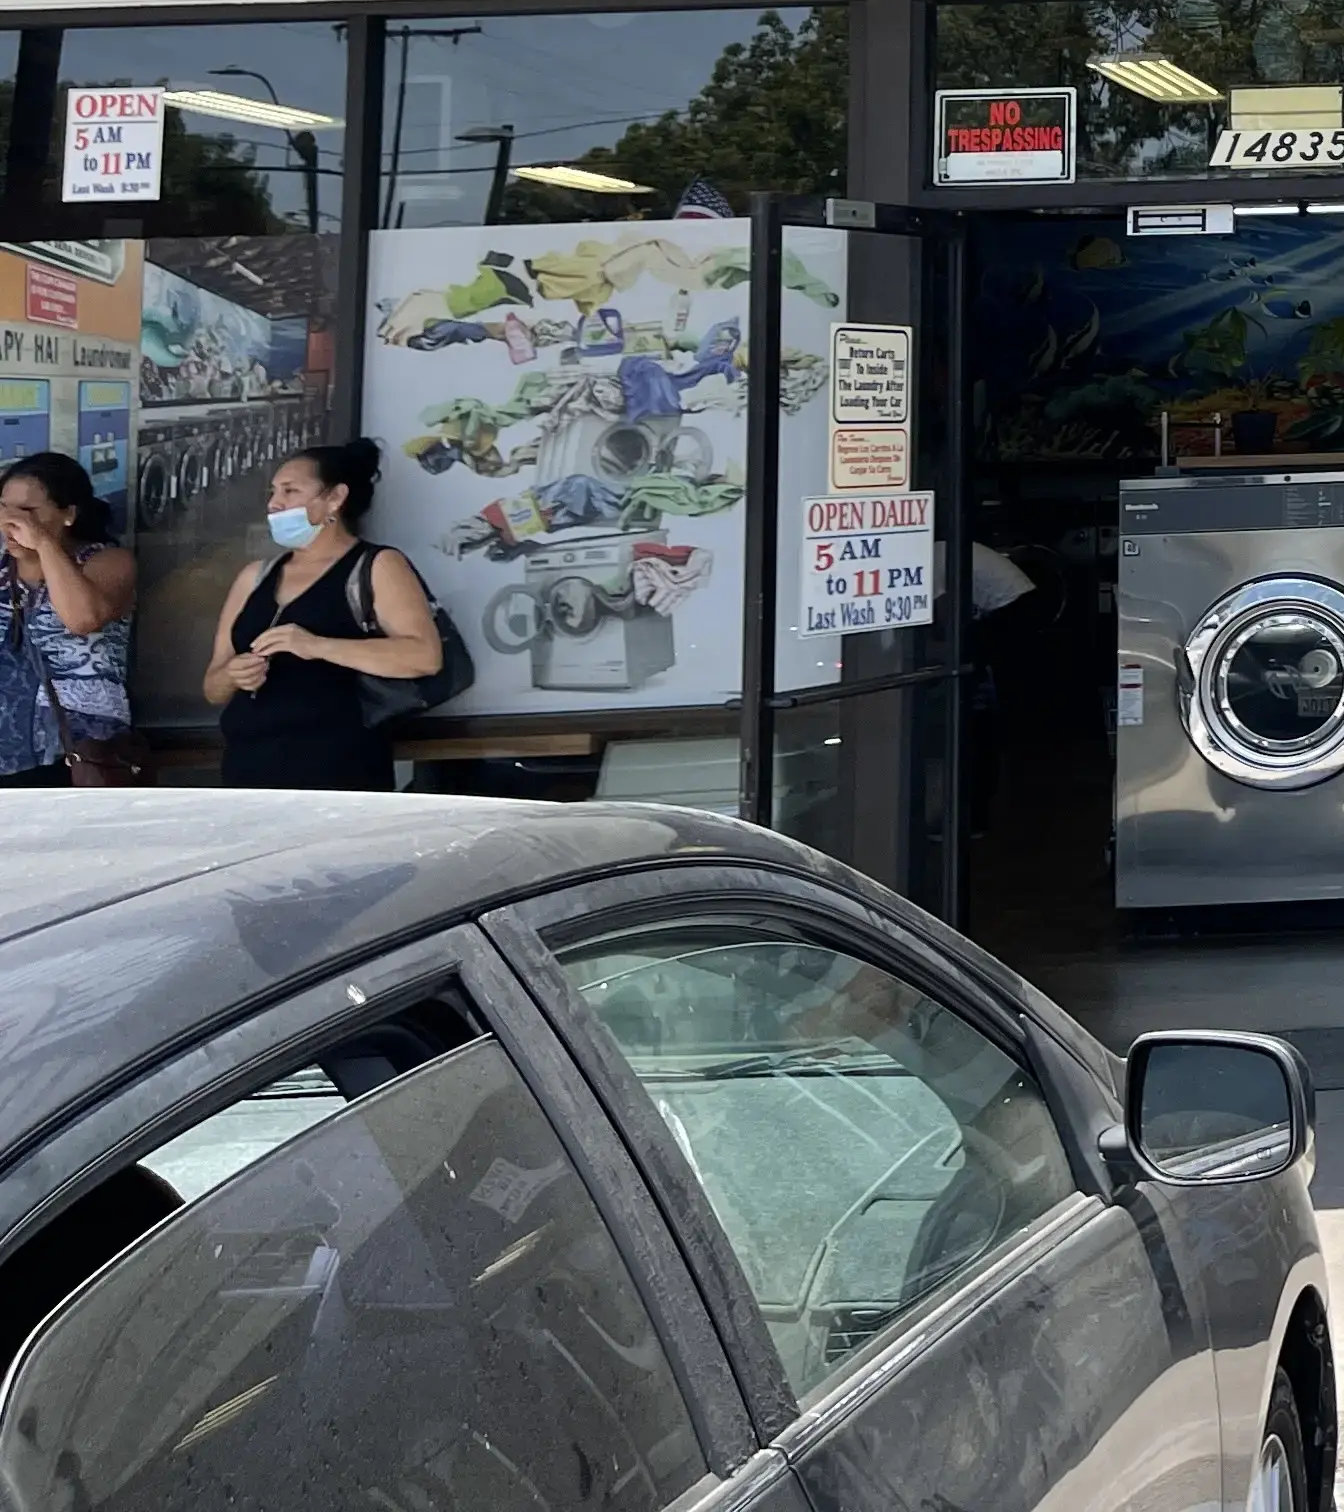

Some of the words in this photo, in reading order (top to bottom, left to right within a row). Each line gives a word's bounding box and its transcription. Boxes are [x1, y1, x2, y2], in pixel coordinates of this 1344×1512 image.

[75, 94, 158, 118] OPEN
[989, 101, 1021, 126] NO
[74, 128, 89, 151] 5
[92, 126, 123, 144] AM
[948, 127, 1063, 152] TRESPASSING
[84, 153, 98, 172] to
[101, 152, 122, 176] 11
[124, 152, 152, 170] PM
[0, 330, 24, 363] PY
[34, 333, 58, 365] HAI
[839, 379, 852, 391] The
[854, 380, 883, 393] Laundry
[886, 380, 904, 391] After
[840, 396, 869, 410] Loading
[890, 396, 902, 407] Car
[808, 501, 866, 532] OPEN
[871, 498, 929, 529] DAILY
[814, 543, 834, 571] 5
[839, 538, 881, 561] AM
[826, 574, 847, 596] to
[853, 569, 884, 598] 11
[887, 566, 923, 588] PM
[806, 606, 836, 631] Last
[840, 600, 875, 627] Wash
[884, 595, 912, 623] 9:30
[913, 594, 928, 609] PM
